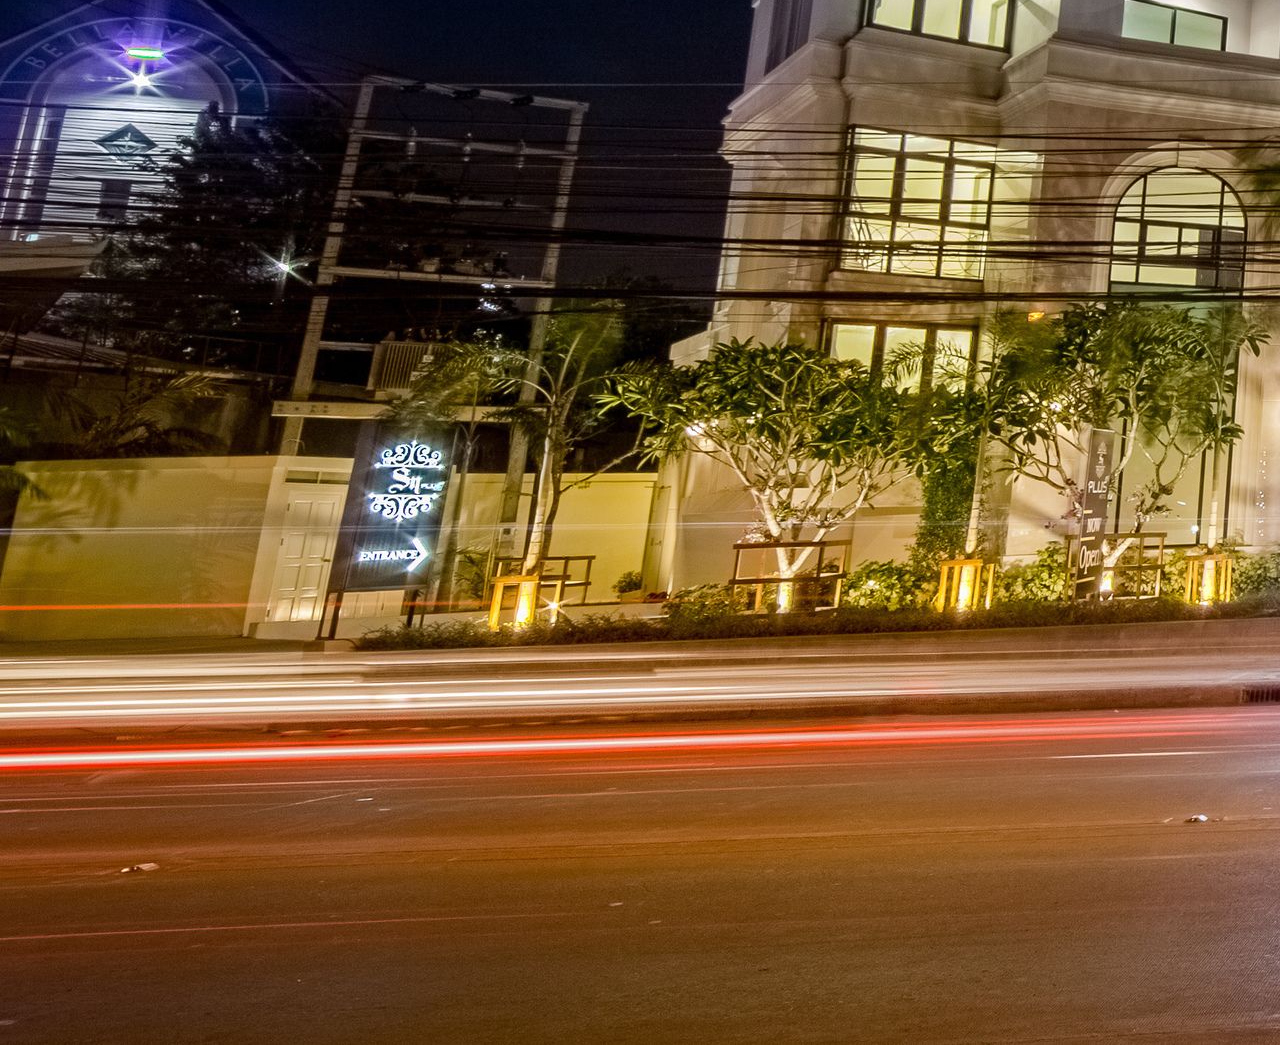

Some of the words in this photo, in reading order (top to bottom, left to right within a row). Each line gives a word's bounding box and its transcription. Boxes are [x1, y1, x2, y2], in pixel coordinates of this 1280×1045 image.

[24, 22, 137, 70] BELLA
[165, 26, 257, 92] VILLA
[1087, 479, 1108, 494] PLUS
[1086, 517, 1103, 534] NOW
[358, 549, 420, 562] ENTRANCE
[1079, 545, 1100, 575] Open
